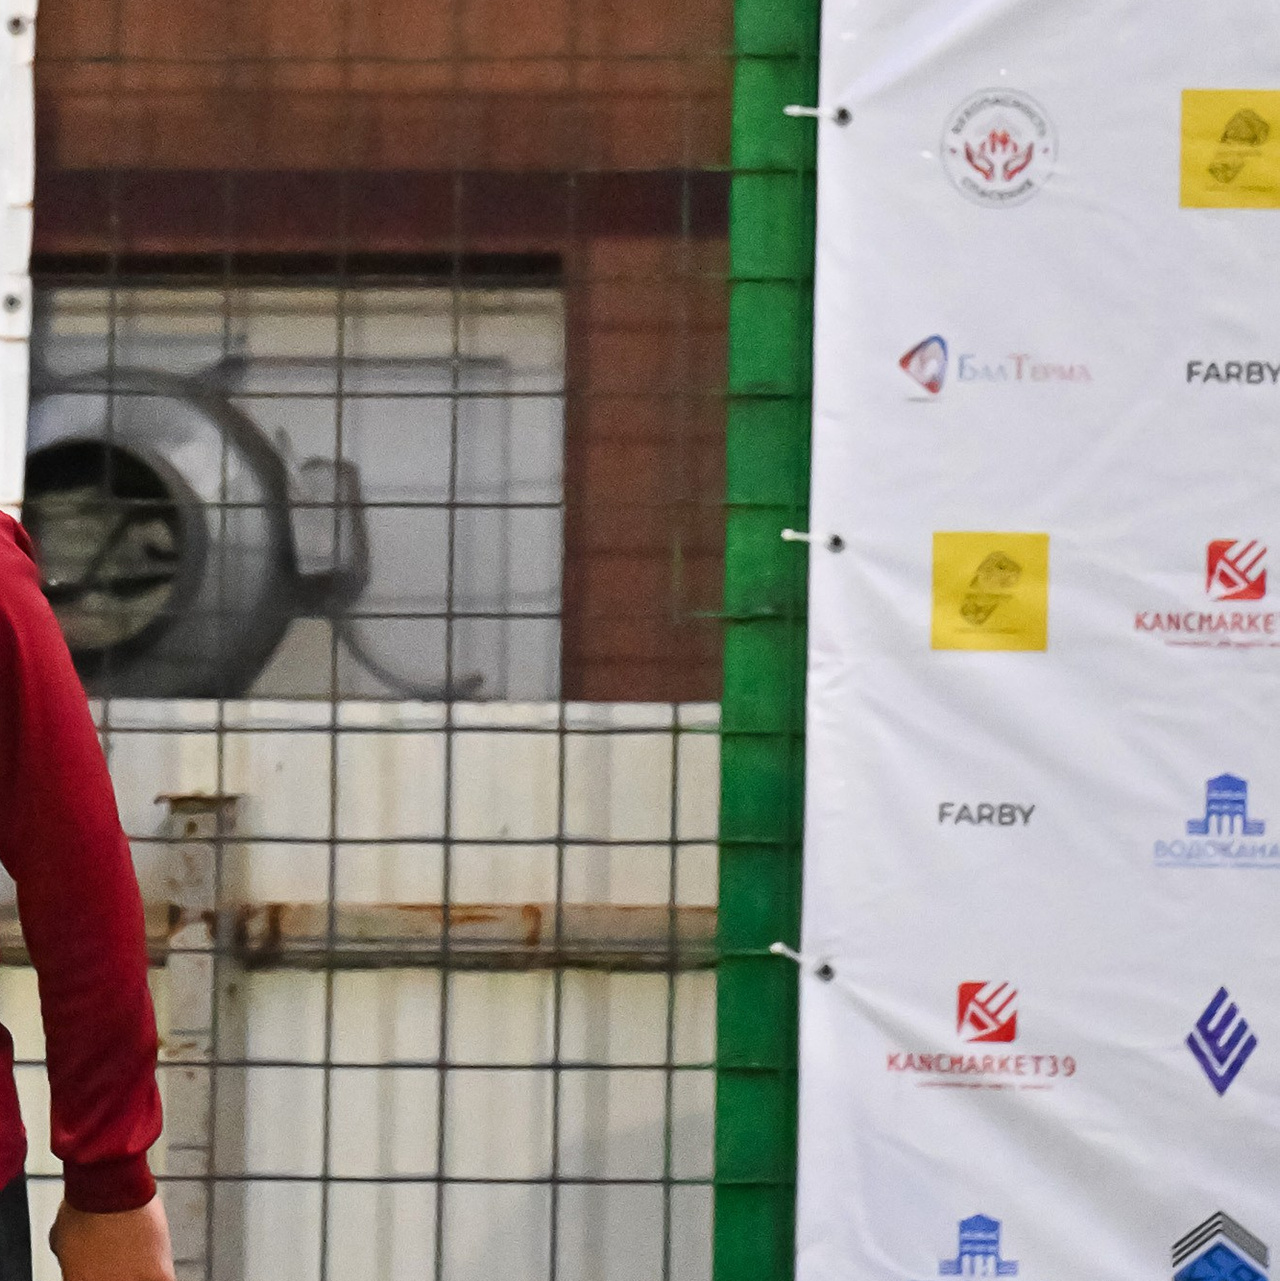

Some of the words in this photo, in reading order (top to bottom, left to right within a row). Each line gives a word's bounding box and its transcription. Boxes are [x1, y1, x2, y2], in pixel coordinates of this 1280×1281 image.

[1185, 360, 1280, 384] FARBY
[1134, 610, 1280, 634] KANCMARKE
[938, 802, 1036, 826] FARBY
